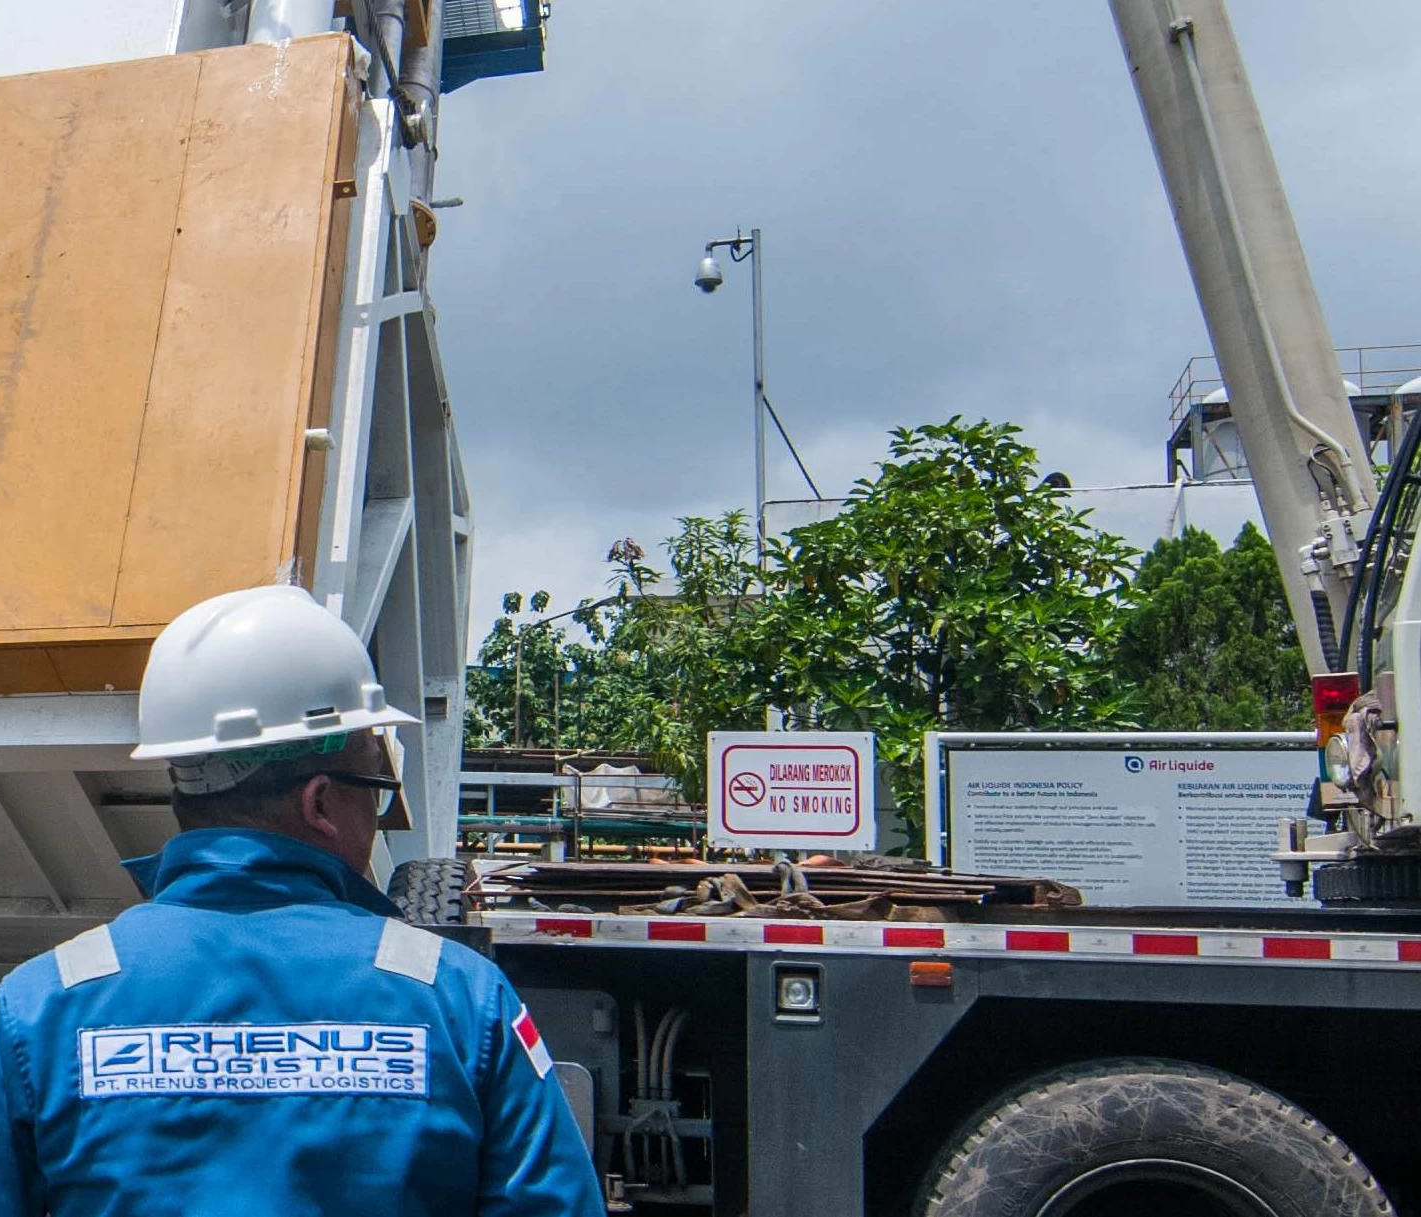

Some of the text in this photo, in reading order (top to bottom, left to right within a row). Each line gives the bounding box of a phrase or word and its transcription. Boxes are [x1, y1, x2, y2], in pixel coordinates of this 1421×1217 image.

[769, 764, 852, 782] DILARANG MEROKOK
[1149, 760, 1215, 773] Air Liquide
[1238, 783, 1270, 791] LIQUIDE
[769, 795, 852, 814] NO SMOKING
[161, 1030, 415, 1054] RHENUS
[161, 1056, 415, 1075] LOGISTICS
[94, 1076, 415, 1092] PT. RHENUS PROJECT LOGISTICS
